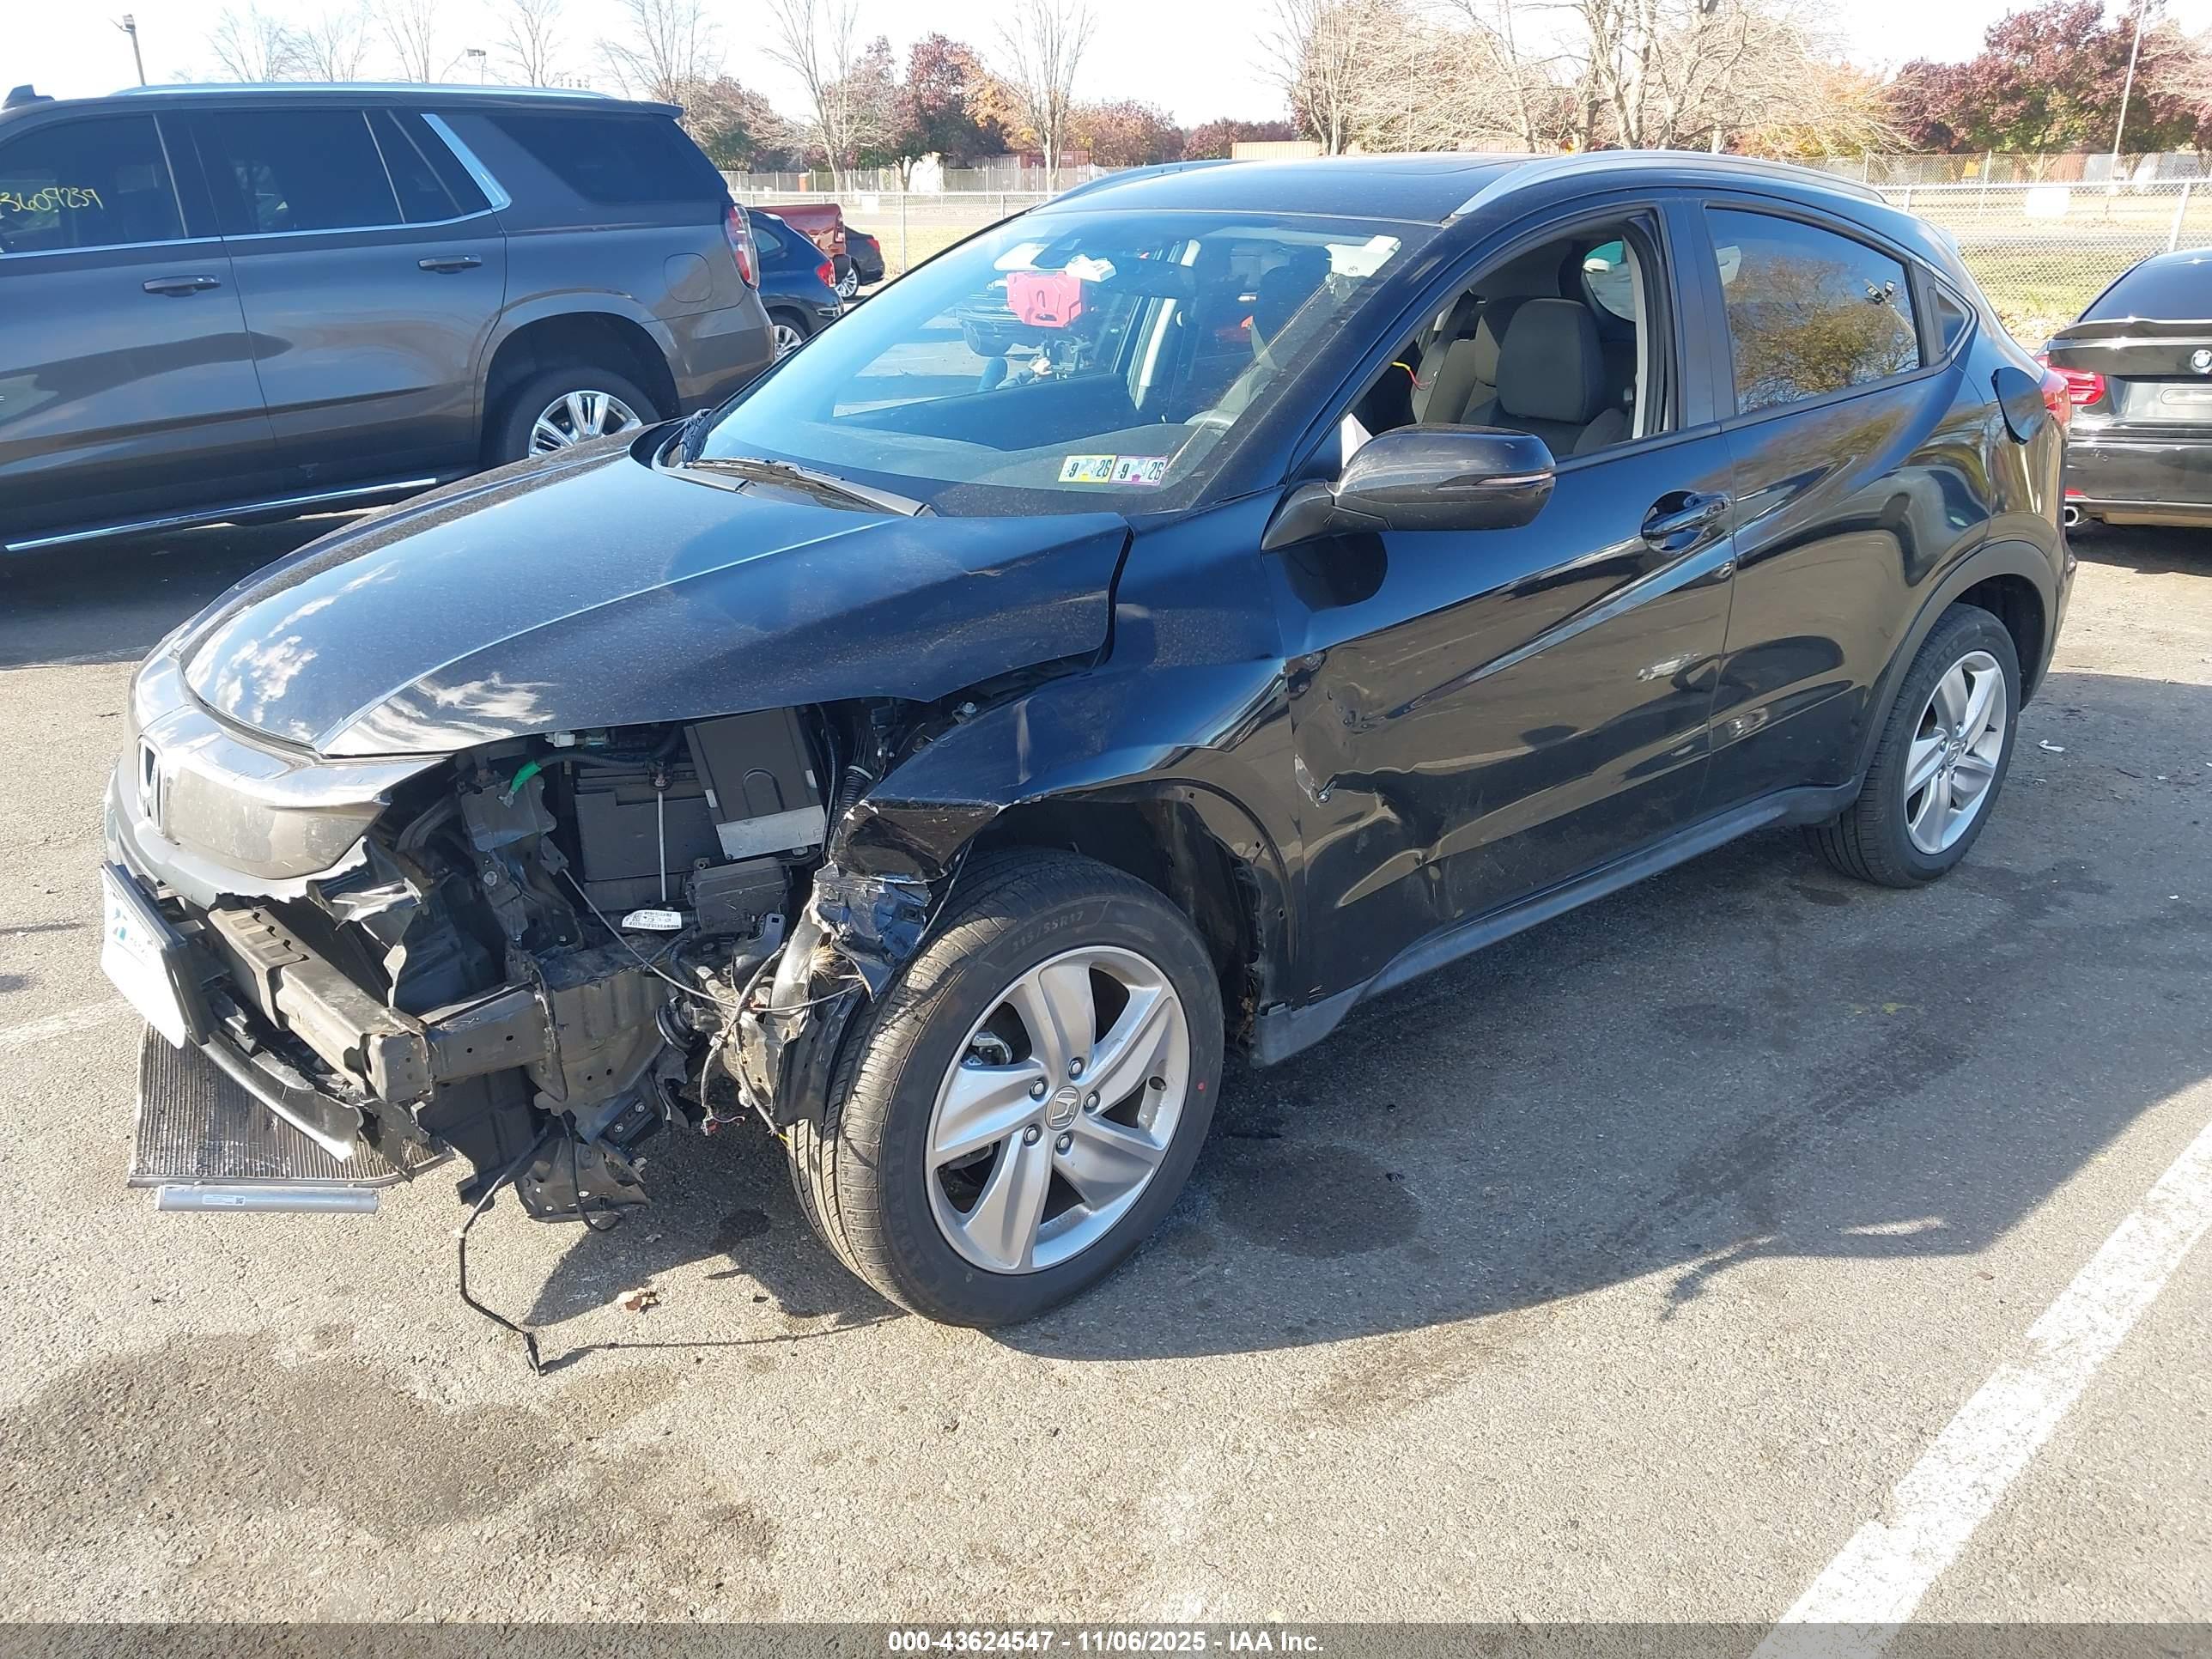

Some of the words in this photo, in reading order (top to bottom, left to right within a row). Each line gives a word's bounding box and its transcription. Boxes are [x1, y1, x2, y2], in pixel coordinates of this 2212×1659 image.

[1068, 462, 1079, 477] 9
[1096, 459, 1113, 477] 26
[1119, 463, 1130, 479] 9
[1147, 461, 1164, 481] 26
